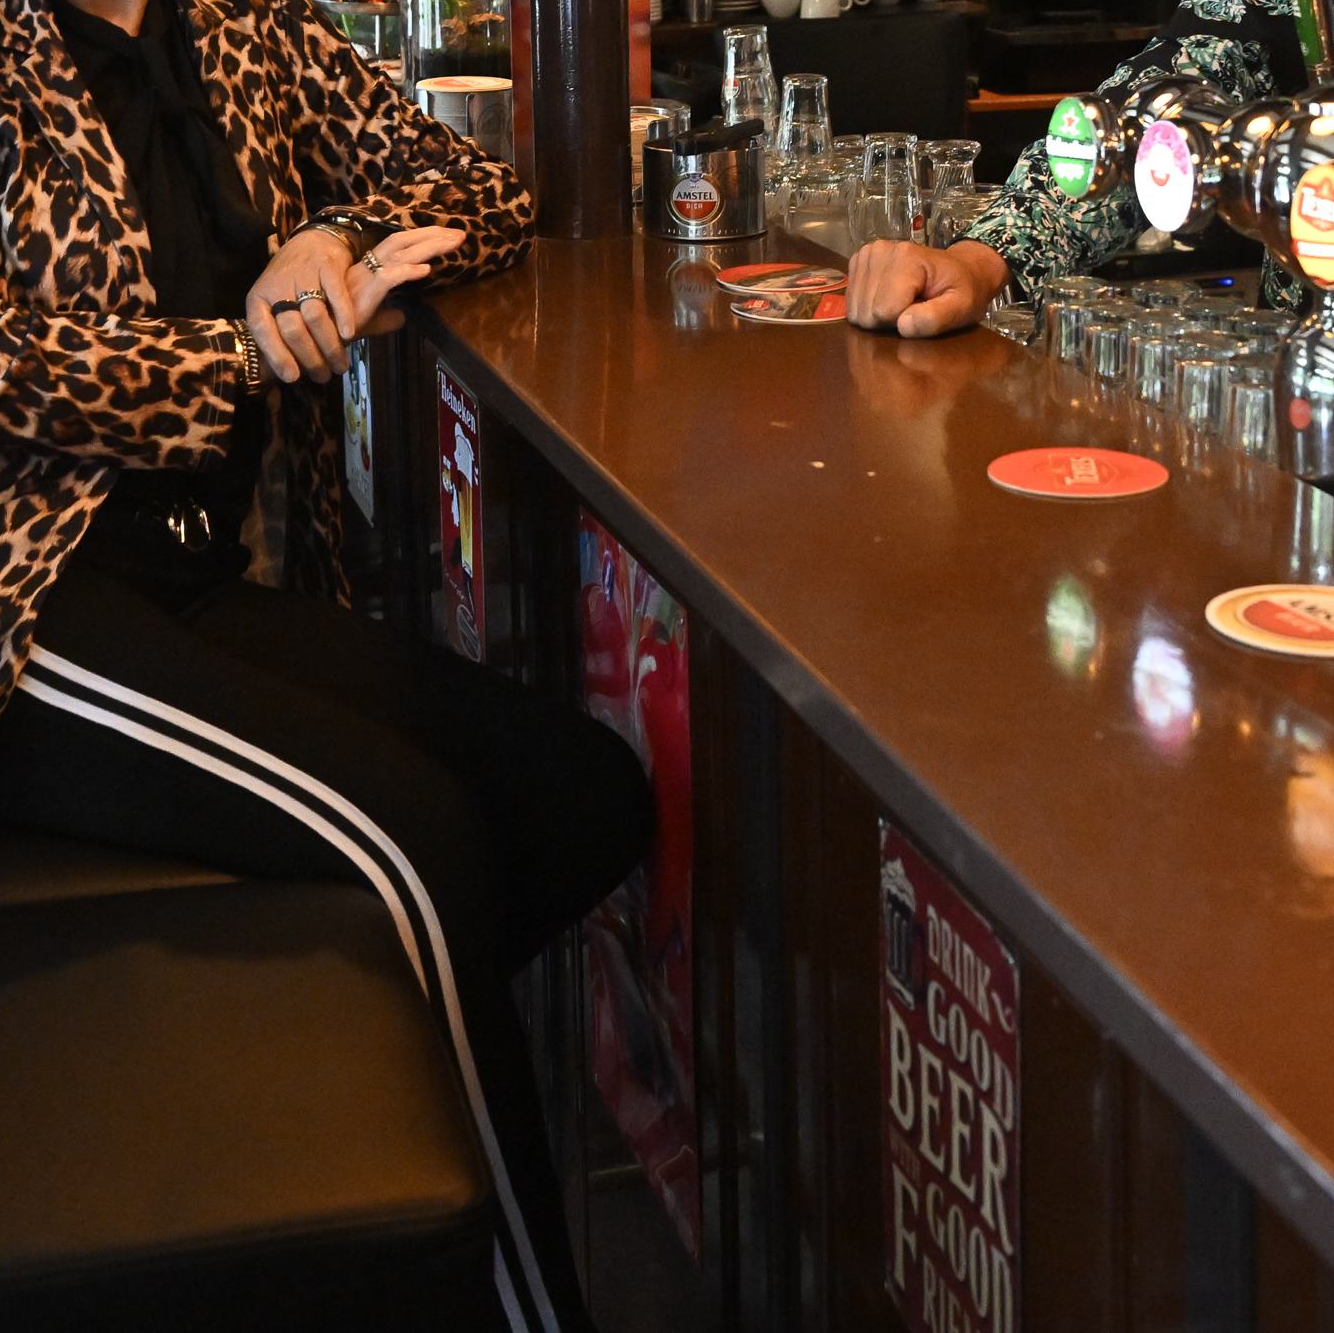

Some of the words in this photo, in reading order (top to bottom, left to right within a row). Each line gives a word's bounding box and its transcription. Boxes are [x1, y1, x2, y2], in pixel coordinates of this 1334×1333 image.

[676, 191, 715, 201] AMSTEL
[437, 369, 476, 435] Heineken
[926, 904, 991, 1026] DRINK
[926, 980, 1014, 1133] GOOD
[887, 999, 1014, 1257] BEER
[926, 1181, 1014, 1333] GOOD
